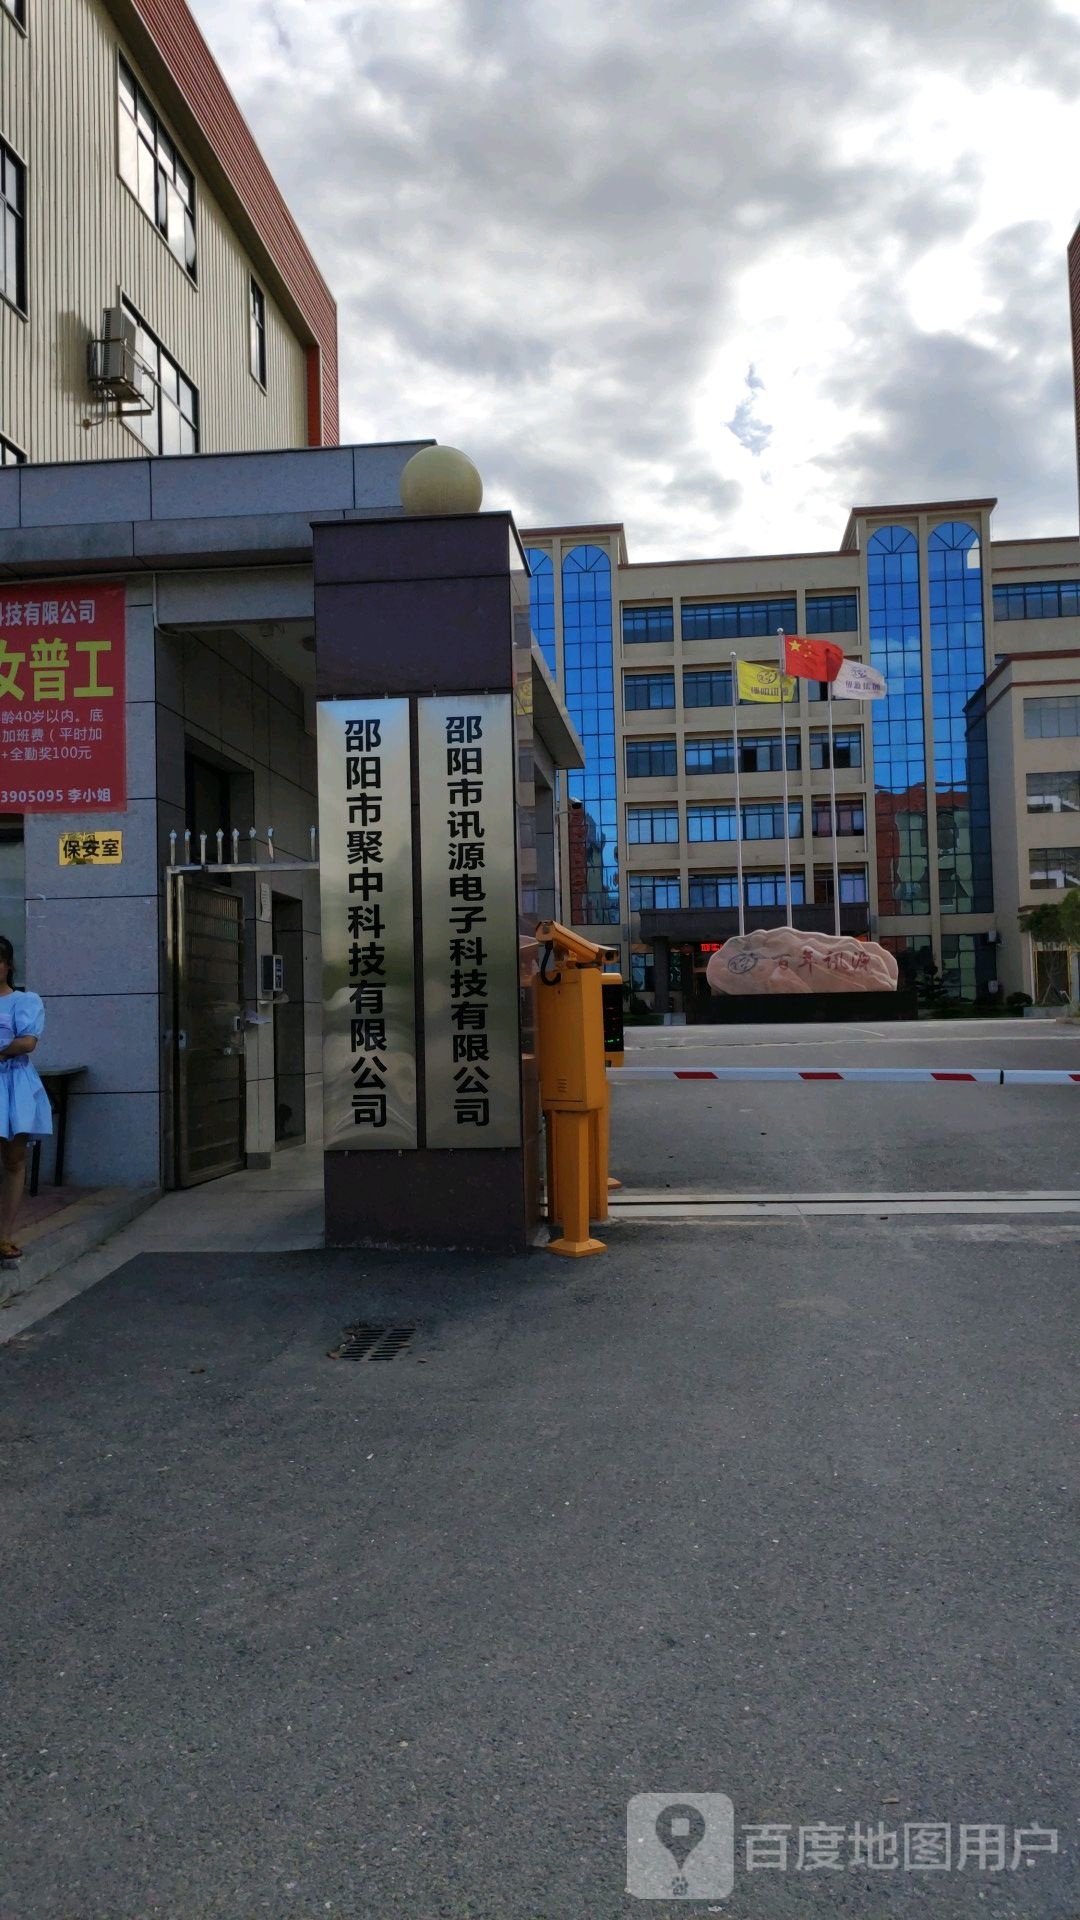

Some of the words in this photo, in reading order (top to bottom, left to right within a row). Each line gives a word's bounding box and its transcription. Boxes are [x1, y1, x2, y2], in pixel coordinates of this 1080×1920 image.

[0, 600, 95, 626] 技有限公司
[0, 637, 113, 701] 女普工
[68, 787, 111, 803] 李小姐
[63, 838, 119, 858] 保安室
[344, 719, 388, 1128] 邵阳市聚中科技有限公司
[445, 715, 490, 1127] 邵阳市讯源电子科技有限公司
